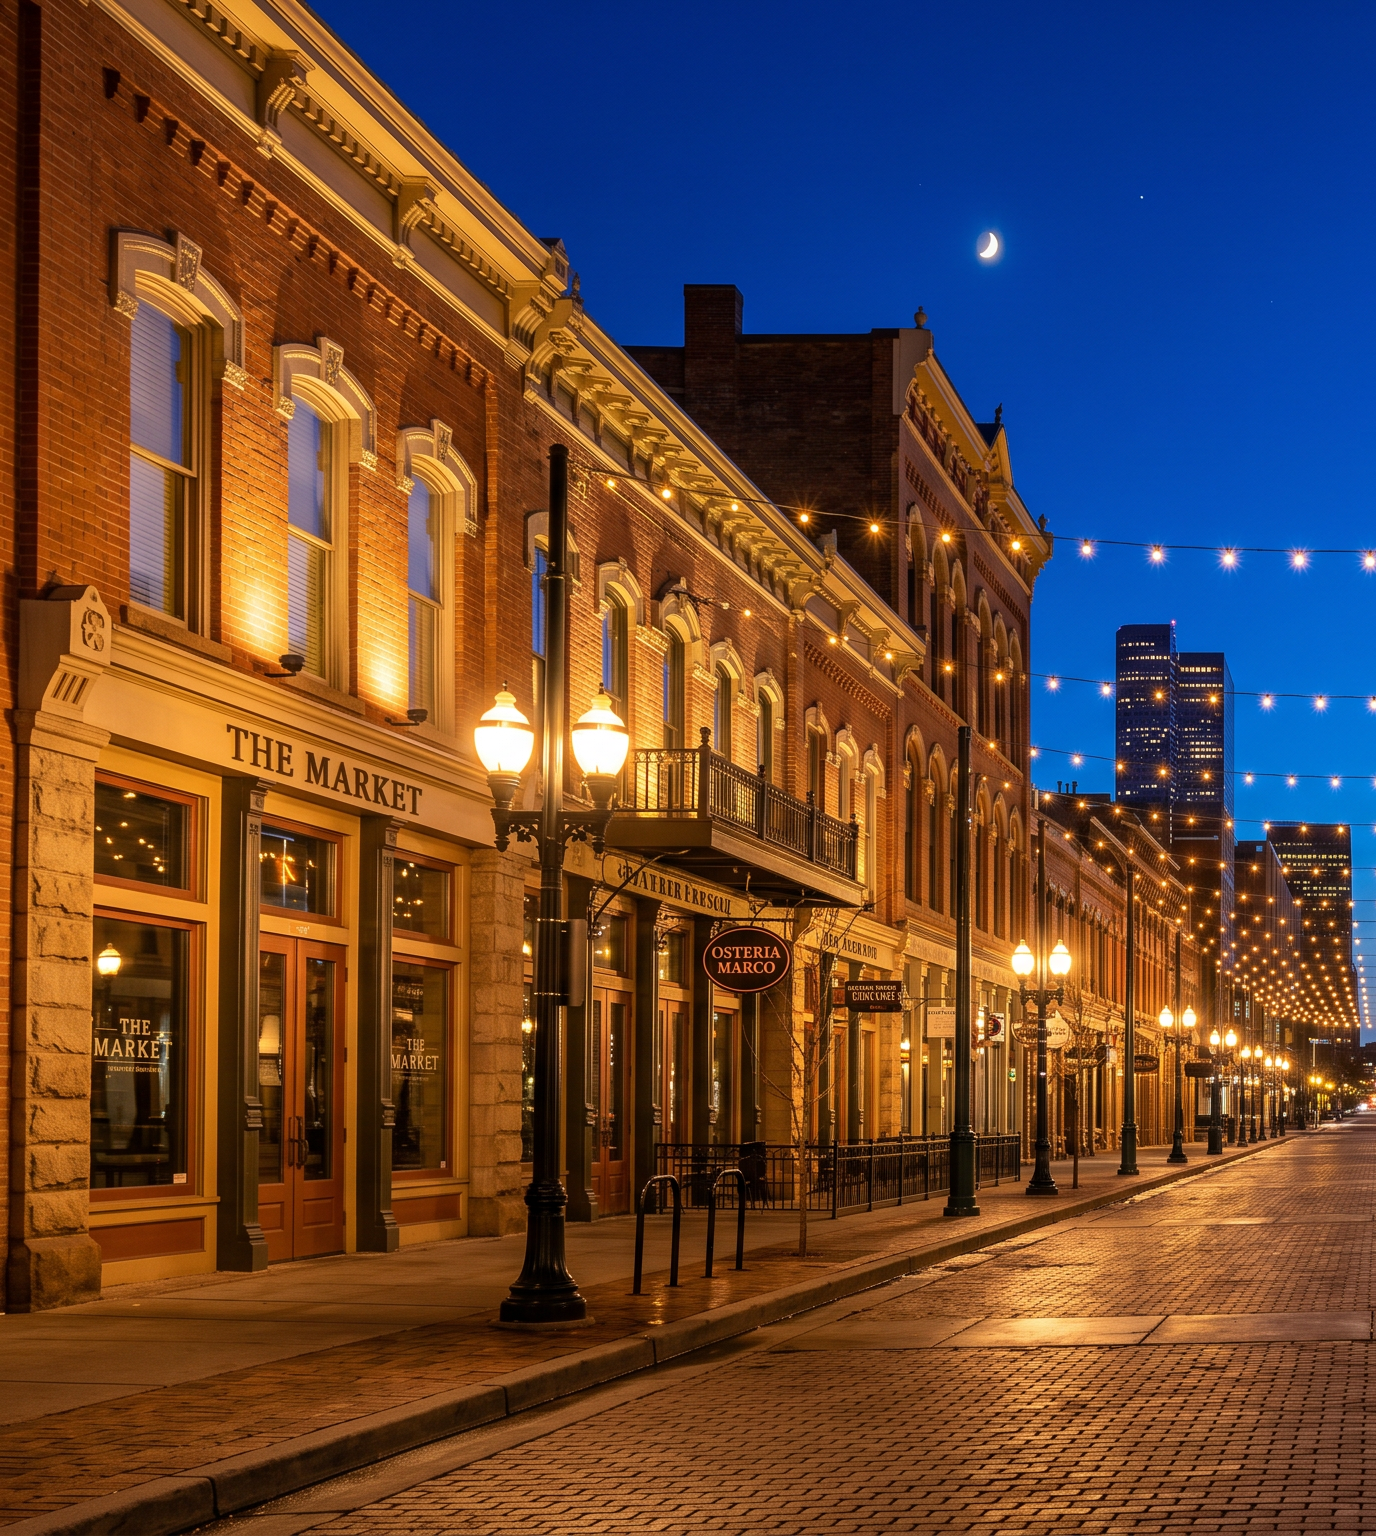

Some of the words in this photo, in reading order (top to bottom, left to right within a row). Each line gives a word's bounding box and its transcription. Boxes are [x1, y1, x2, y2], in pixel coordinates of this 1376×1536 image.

[226, 723, 294, 777] THE
[305, 751, 423, 816] MARKET
[711, 946, 781, 959] OSTERIA
[717, 961, 776, 974] MARCO
[119, 1018, 151, 1036] THE
[94, 1037, 173, 1060] MARKET
[406, 1038, 425, 1052] THE
[391, 1054, 439, 1070] MARKET
